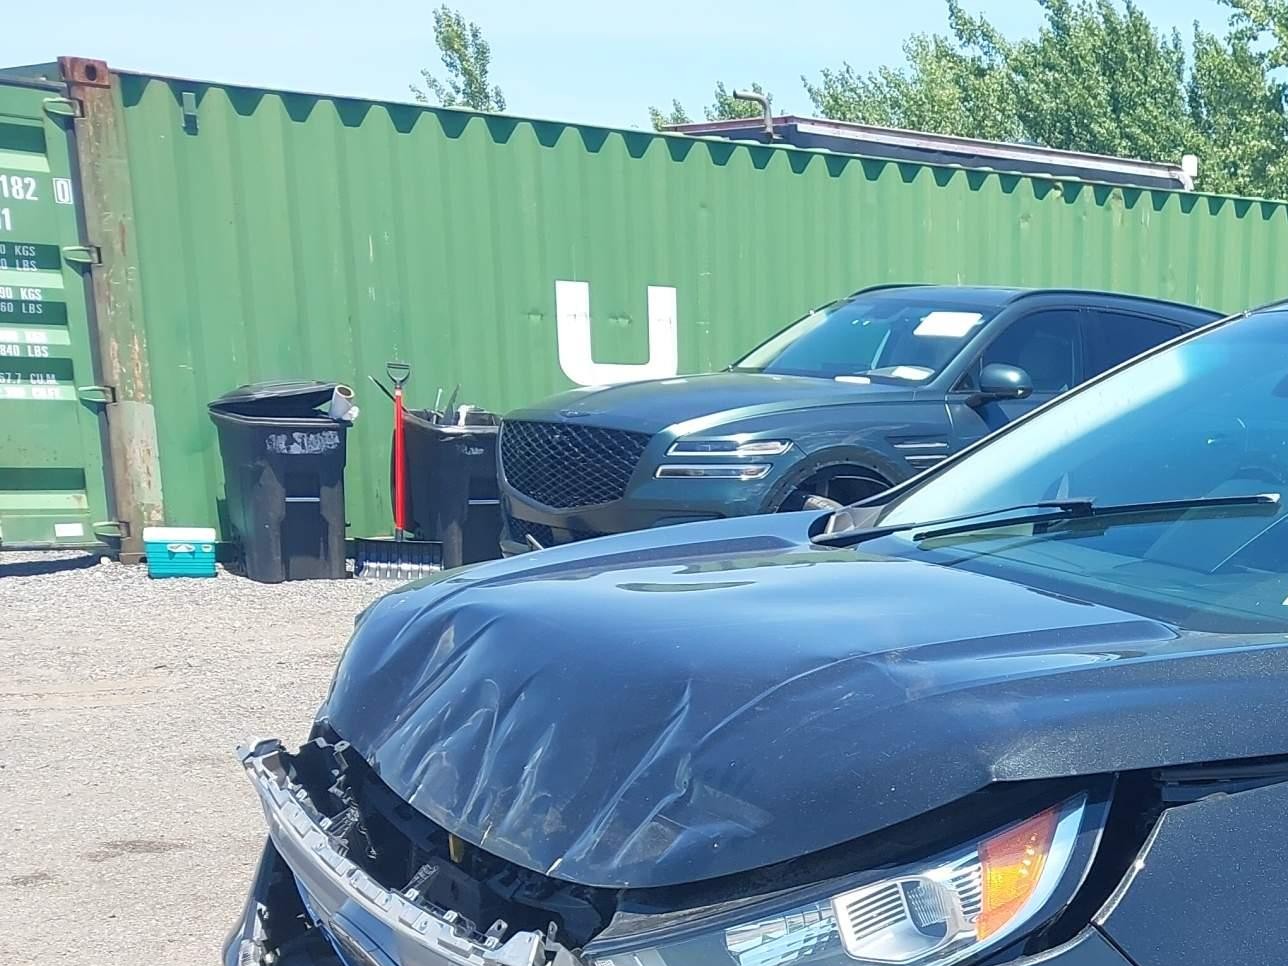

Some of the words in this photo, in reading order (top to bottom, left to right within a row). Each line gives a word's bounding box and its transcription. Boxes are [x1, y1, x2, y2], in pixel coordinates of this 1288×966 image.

[14, 245, 36, 257] KGS
[15, 259, 38, 272] LBS
[20, 287, 42, 301] KGS
[22, 302, 43, 314] LBS
[555, 280, 678, 387] U
[27, 345, 49, 358] LBS
